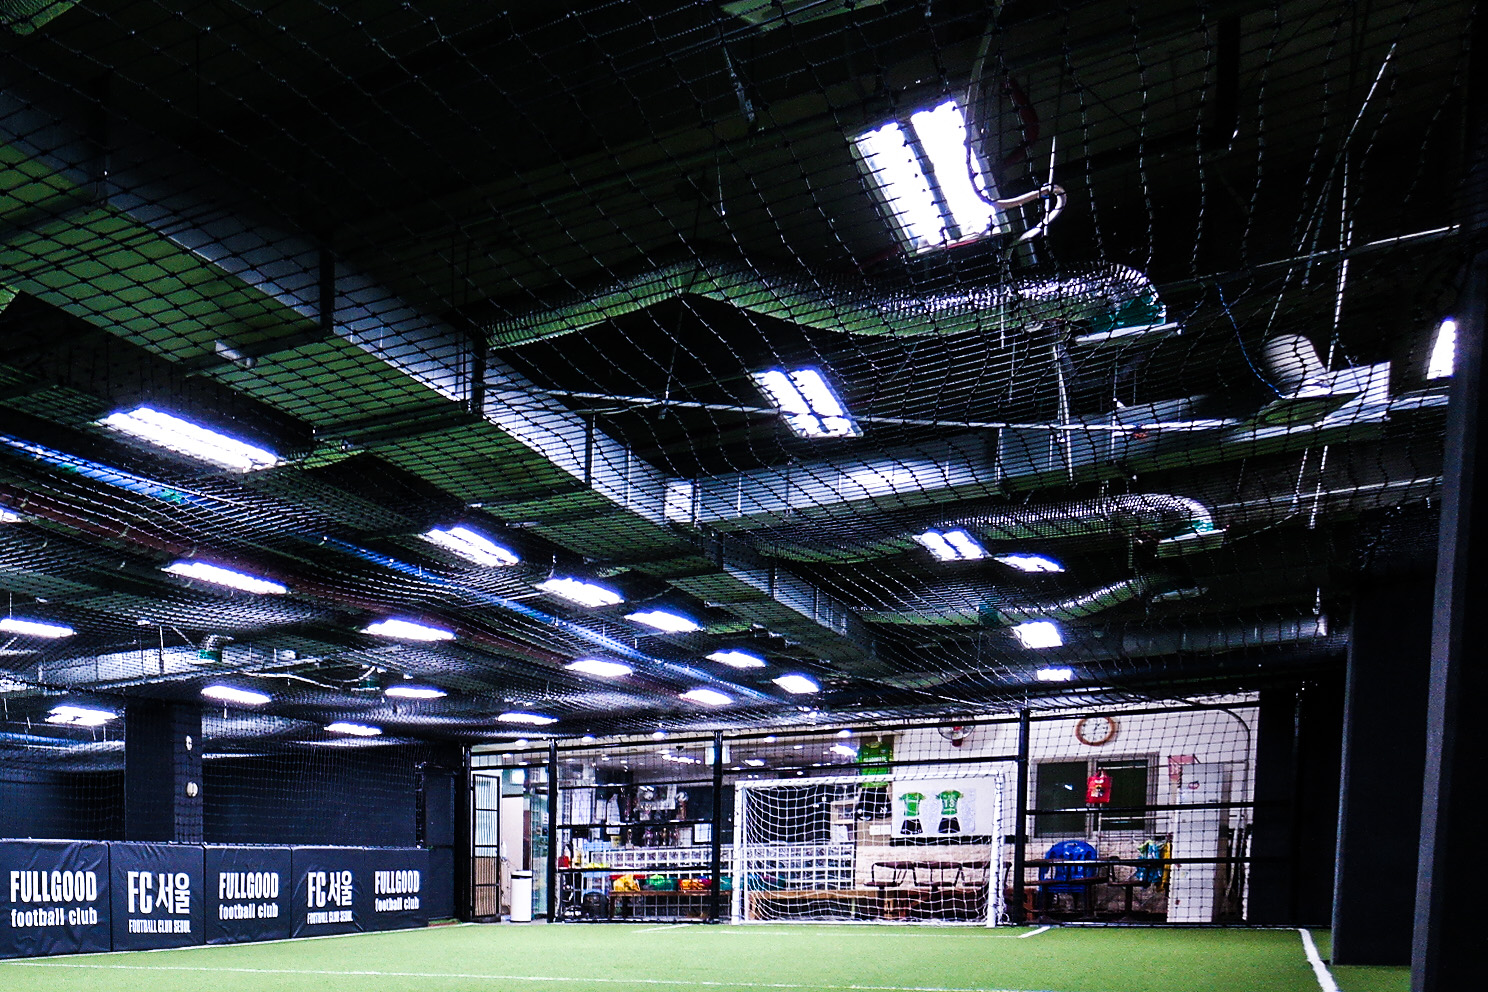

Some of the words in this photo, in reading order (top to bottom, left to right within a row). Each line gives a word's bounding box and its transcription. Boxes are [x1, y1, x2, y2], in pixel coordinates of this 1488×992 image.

[10, 870, 98, 903] FULLGOOD
[127, 870, 153, 914] FC
[155, 872, 191, 914] 서울
[218, 871, 279, 900] FULLGOOD
[307, 871, 326, 908] FC
[327, 870, 353, 907] 서울
[374, 869, 420, 895] FULLGOOD
[10, 907, 65, 928] football
[68, 906, 98, 926] club
[218, 902, 256, 920] football
[257, 902, 279, 919] club
[375, 896, 403, 912] football
[403, 896, 420, 910] club
